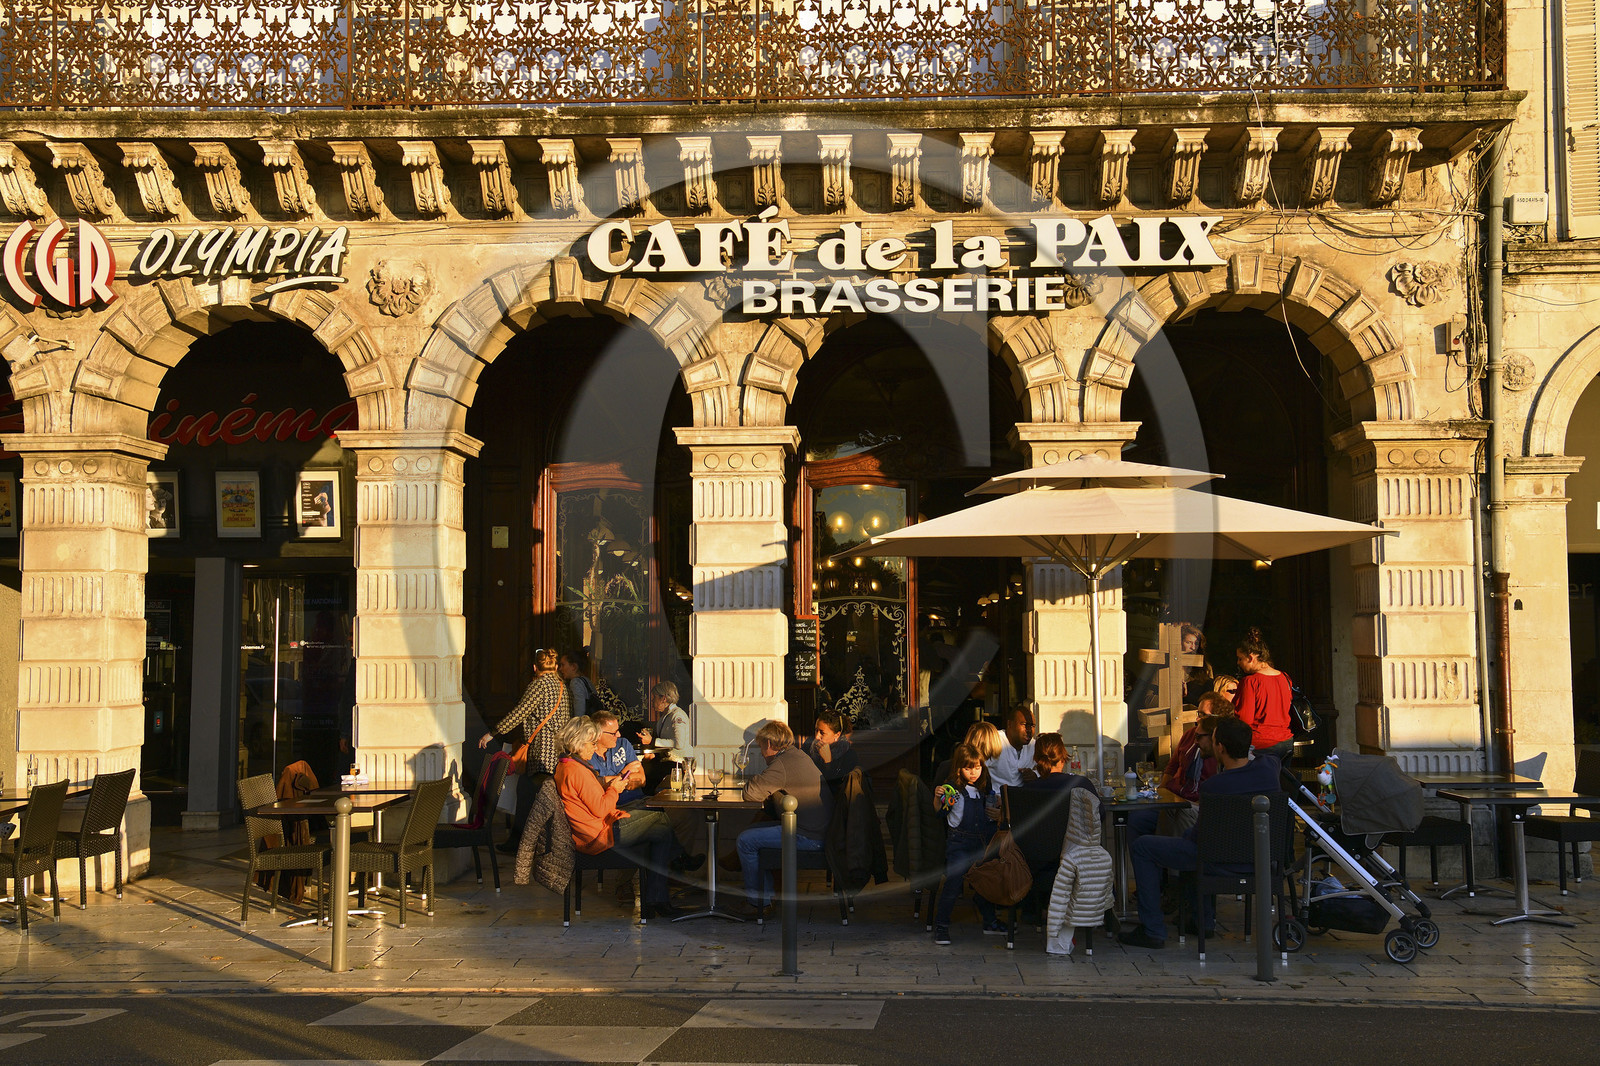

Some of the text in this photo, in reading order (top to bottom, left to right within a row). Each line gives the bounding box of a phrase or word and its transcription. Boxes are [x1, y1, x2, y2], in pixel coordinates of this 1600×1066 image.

[3, 217, 119, 308] CGR
[139, 225, 349, 276] OLYMPIA
[587, 206, 1229, 274] CAFÉ de la PAIX
[742, 276, 1066, 315] BRASSERIE
[146, 392, 358, 447] inéma
